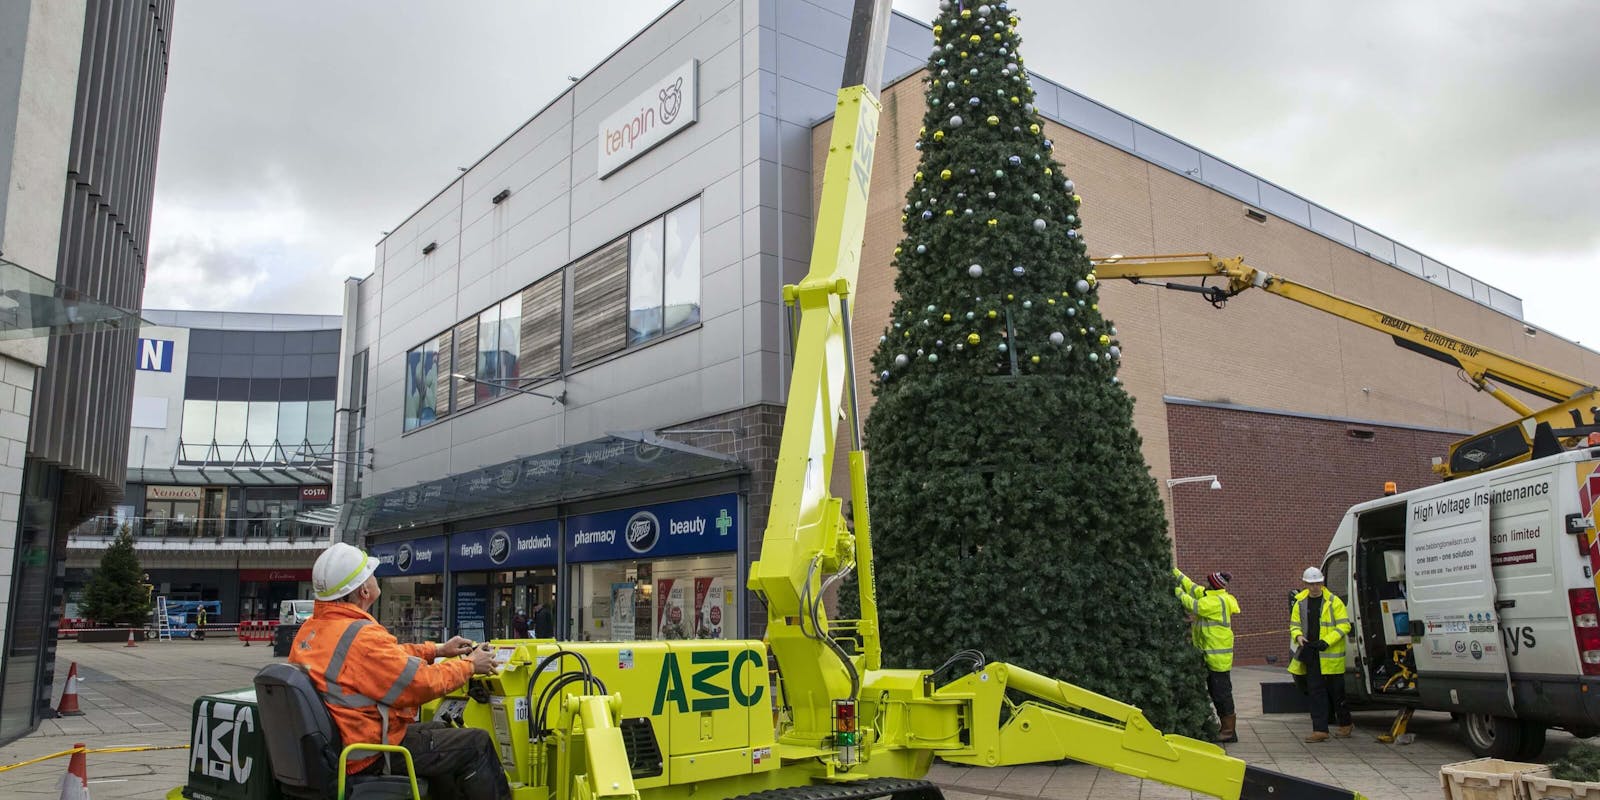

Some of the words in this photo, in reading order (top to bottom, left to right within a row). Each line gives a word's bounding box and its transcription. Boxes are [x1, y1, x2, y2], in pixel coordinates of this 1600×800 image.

[605, 107, 655, 156] tenpin
[1380, 314, 1412, 333] VERSALIFT
[1423, 331, 1458, 352] EUROTEL
[1458, 343, 1480, 358] 38NF
[152, 487, 198, 499] Nando's
[303, 488, 326, 496] COSTA
[1413, 503, 1433, 522] High
[1436, 497, 1470, 514] Voltage
[574, 529, 616, 548] pharmacy
[629, 520, 651, 543] Boots
[669, 516, 707, 536] beauty
[1510, 525, 1540, 541] limited
[517, 534, 552, 550] harddwch
[415, 549, 432, 562] beauty
[1416, 557, 1426, 565] one
[1427, 555, 1438, 563] team
[1442, 553, 1452, 561] one
[1453, 549, 1474, 560] solution
